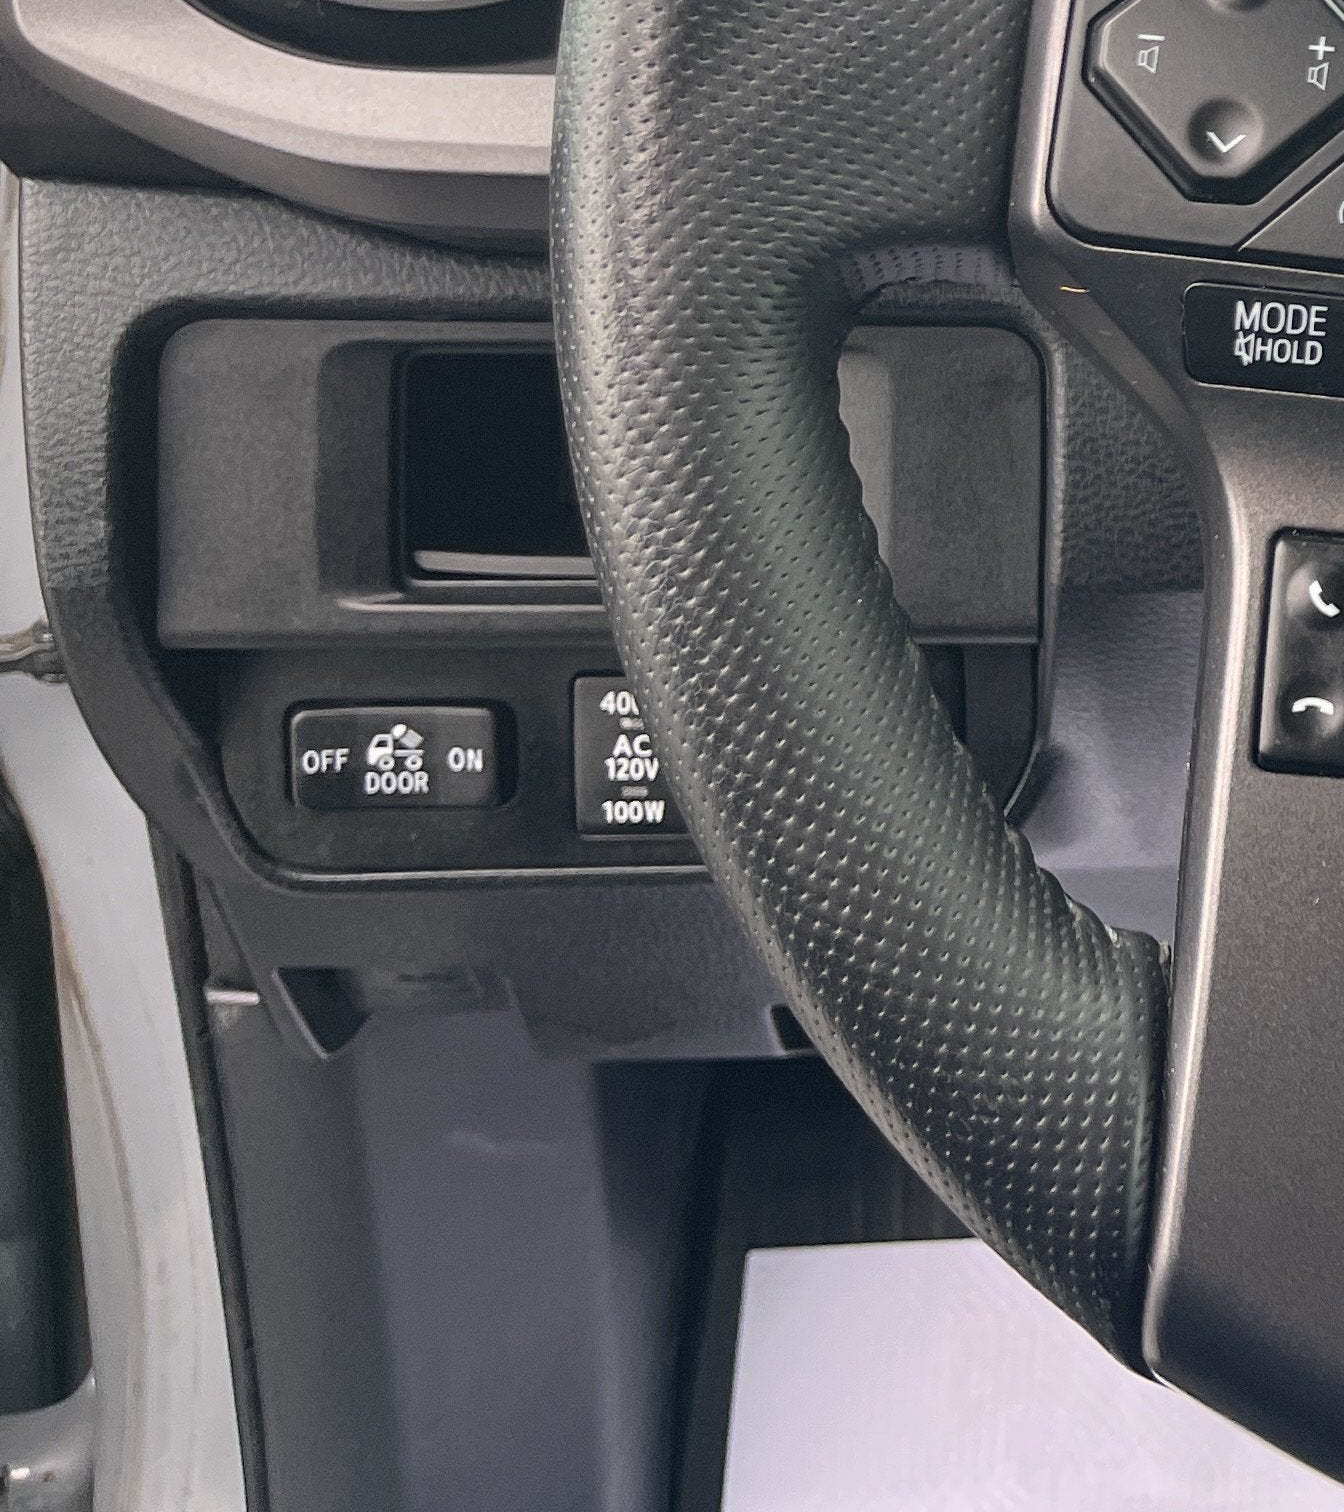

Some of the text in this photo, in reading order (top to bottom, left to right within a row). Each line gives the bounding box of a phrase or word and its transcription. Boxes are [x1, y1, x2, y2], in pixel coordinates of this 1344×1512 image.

[1234, 300, 1328, 337] MODE
[1255, 336, 1323, 366] HOLD
[613, 734, 652, 758] AC
[301, 749, 350, 775] OFF
[447, 748, 483, 771] ON
[604, 757, 659, 782] 120V
[364, 771, 429, 795] DOOR
[602, 799, 665, 824] 100W
